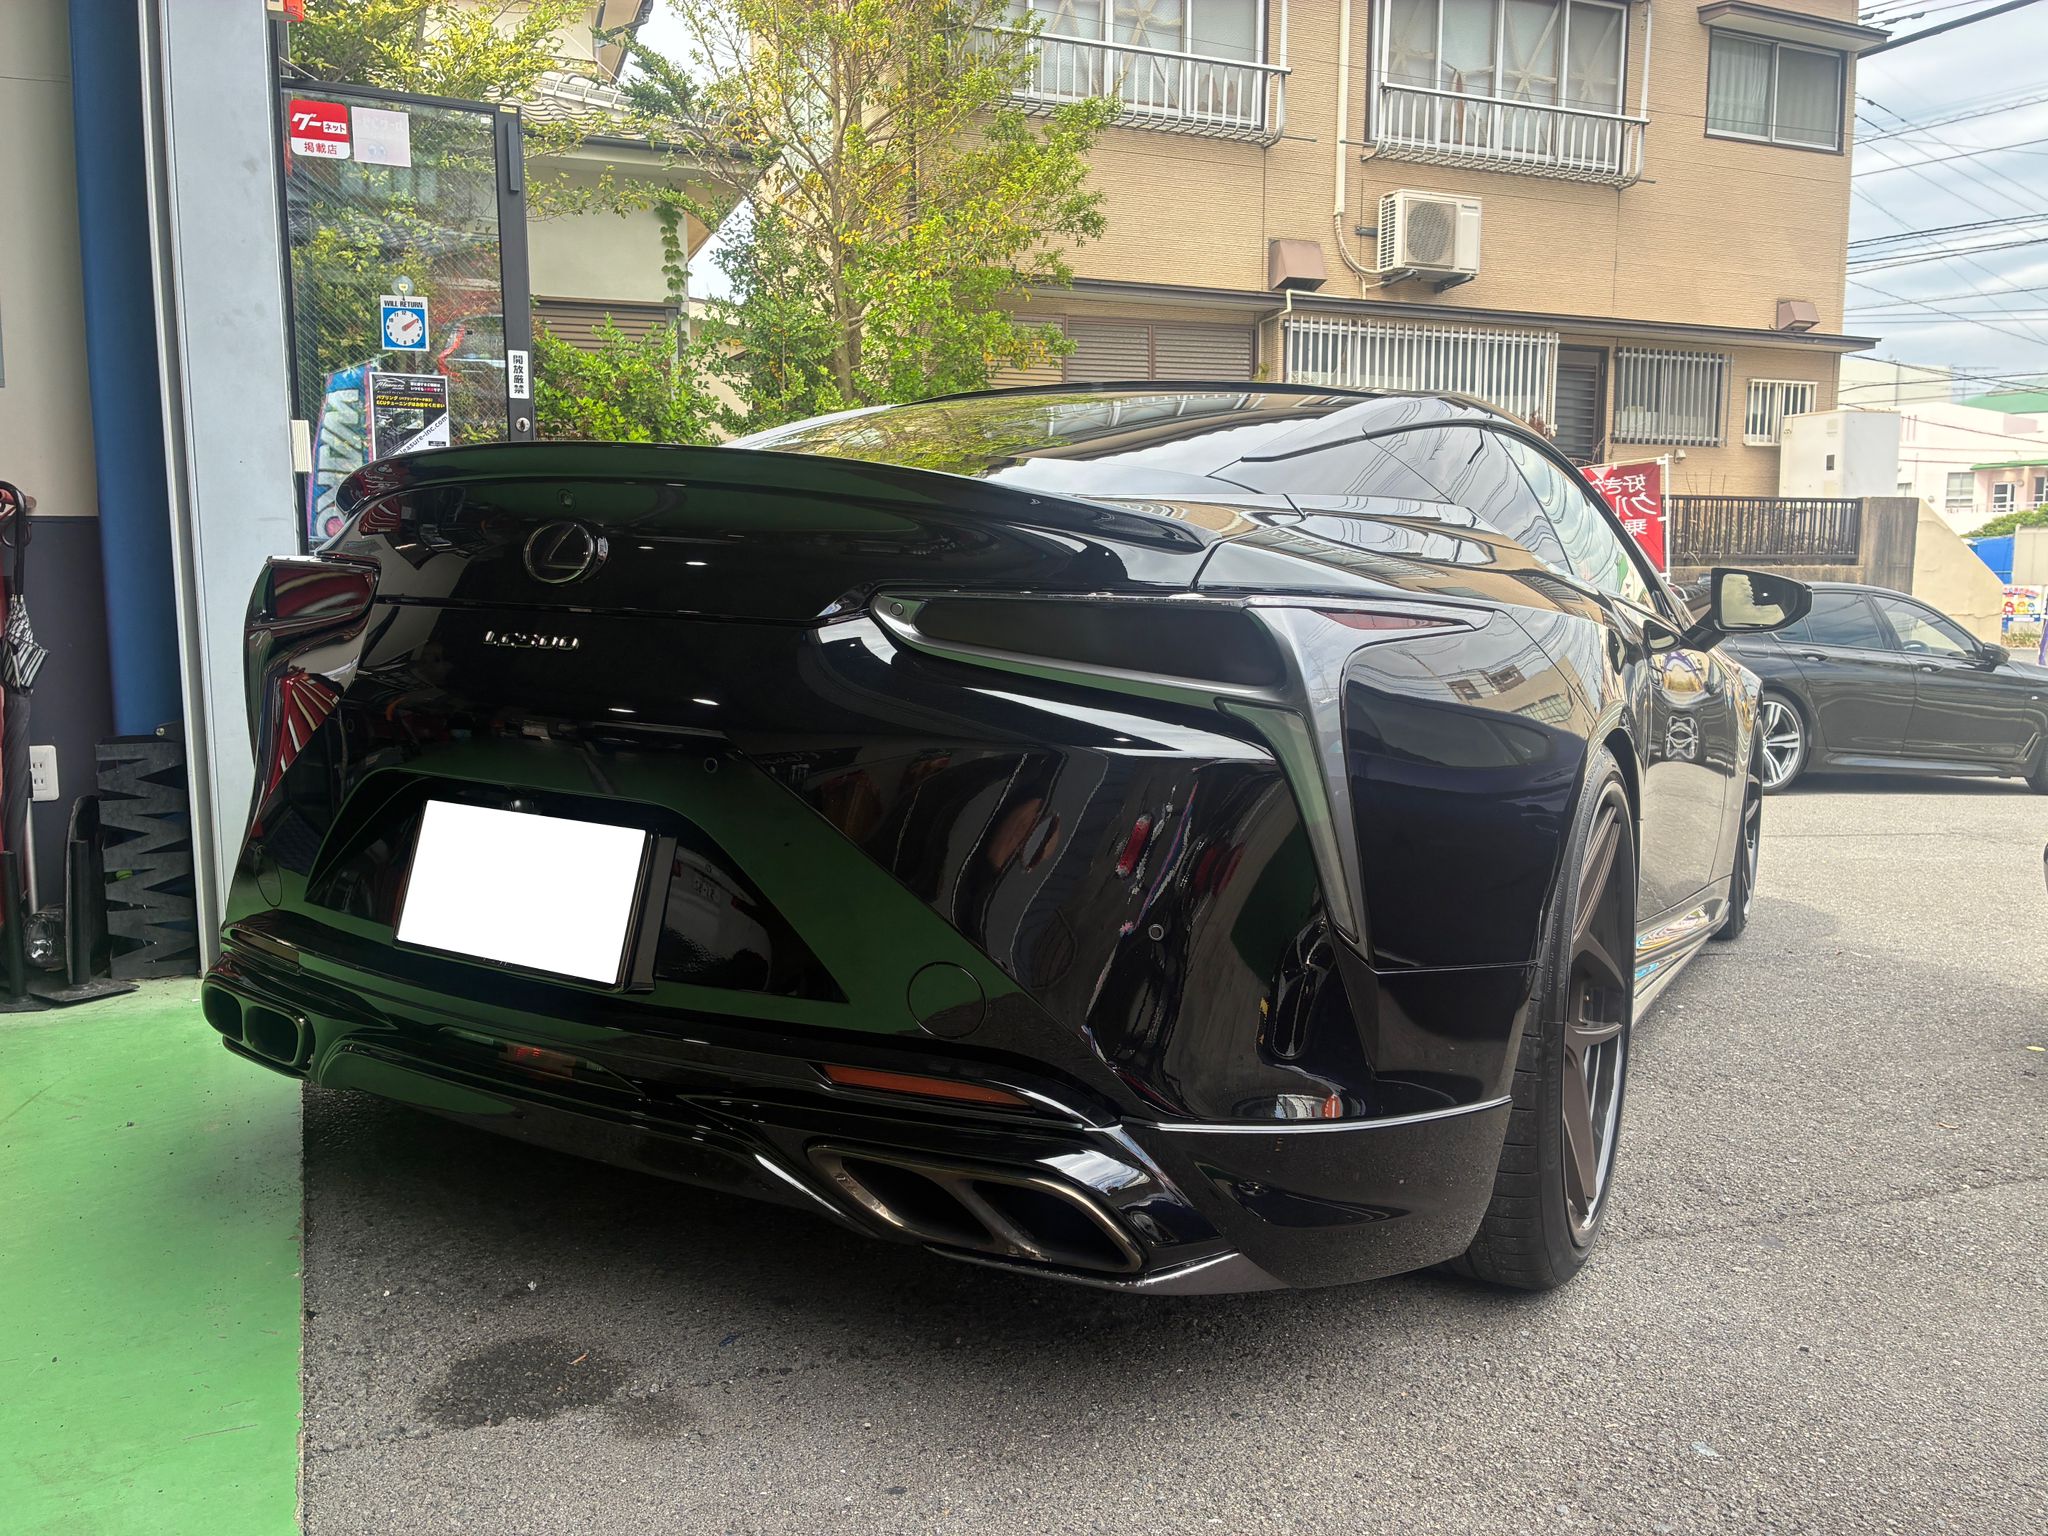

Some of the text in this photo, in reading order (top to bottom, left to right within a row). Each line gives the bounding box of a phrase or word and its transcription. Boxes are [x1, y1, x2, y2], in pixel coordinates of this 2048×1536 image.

[304, 142, 338, 155] 掲載店
[513, 354, 525, 394] 開放厳禁
[400, 416, 448, 454] leasure-inc.com
